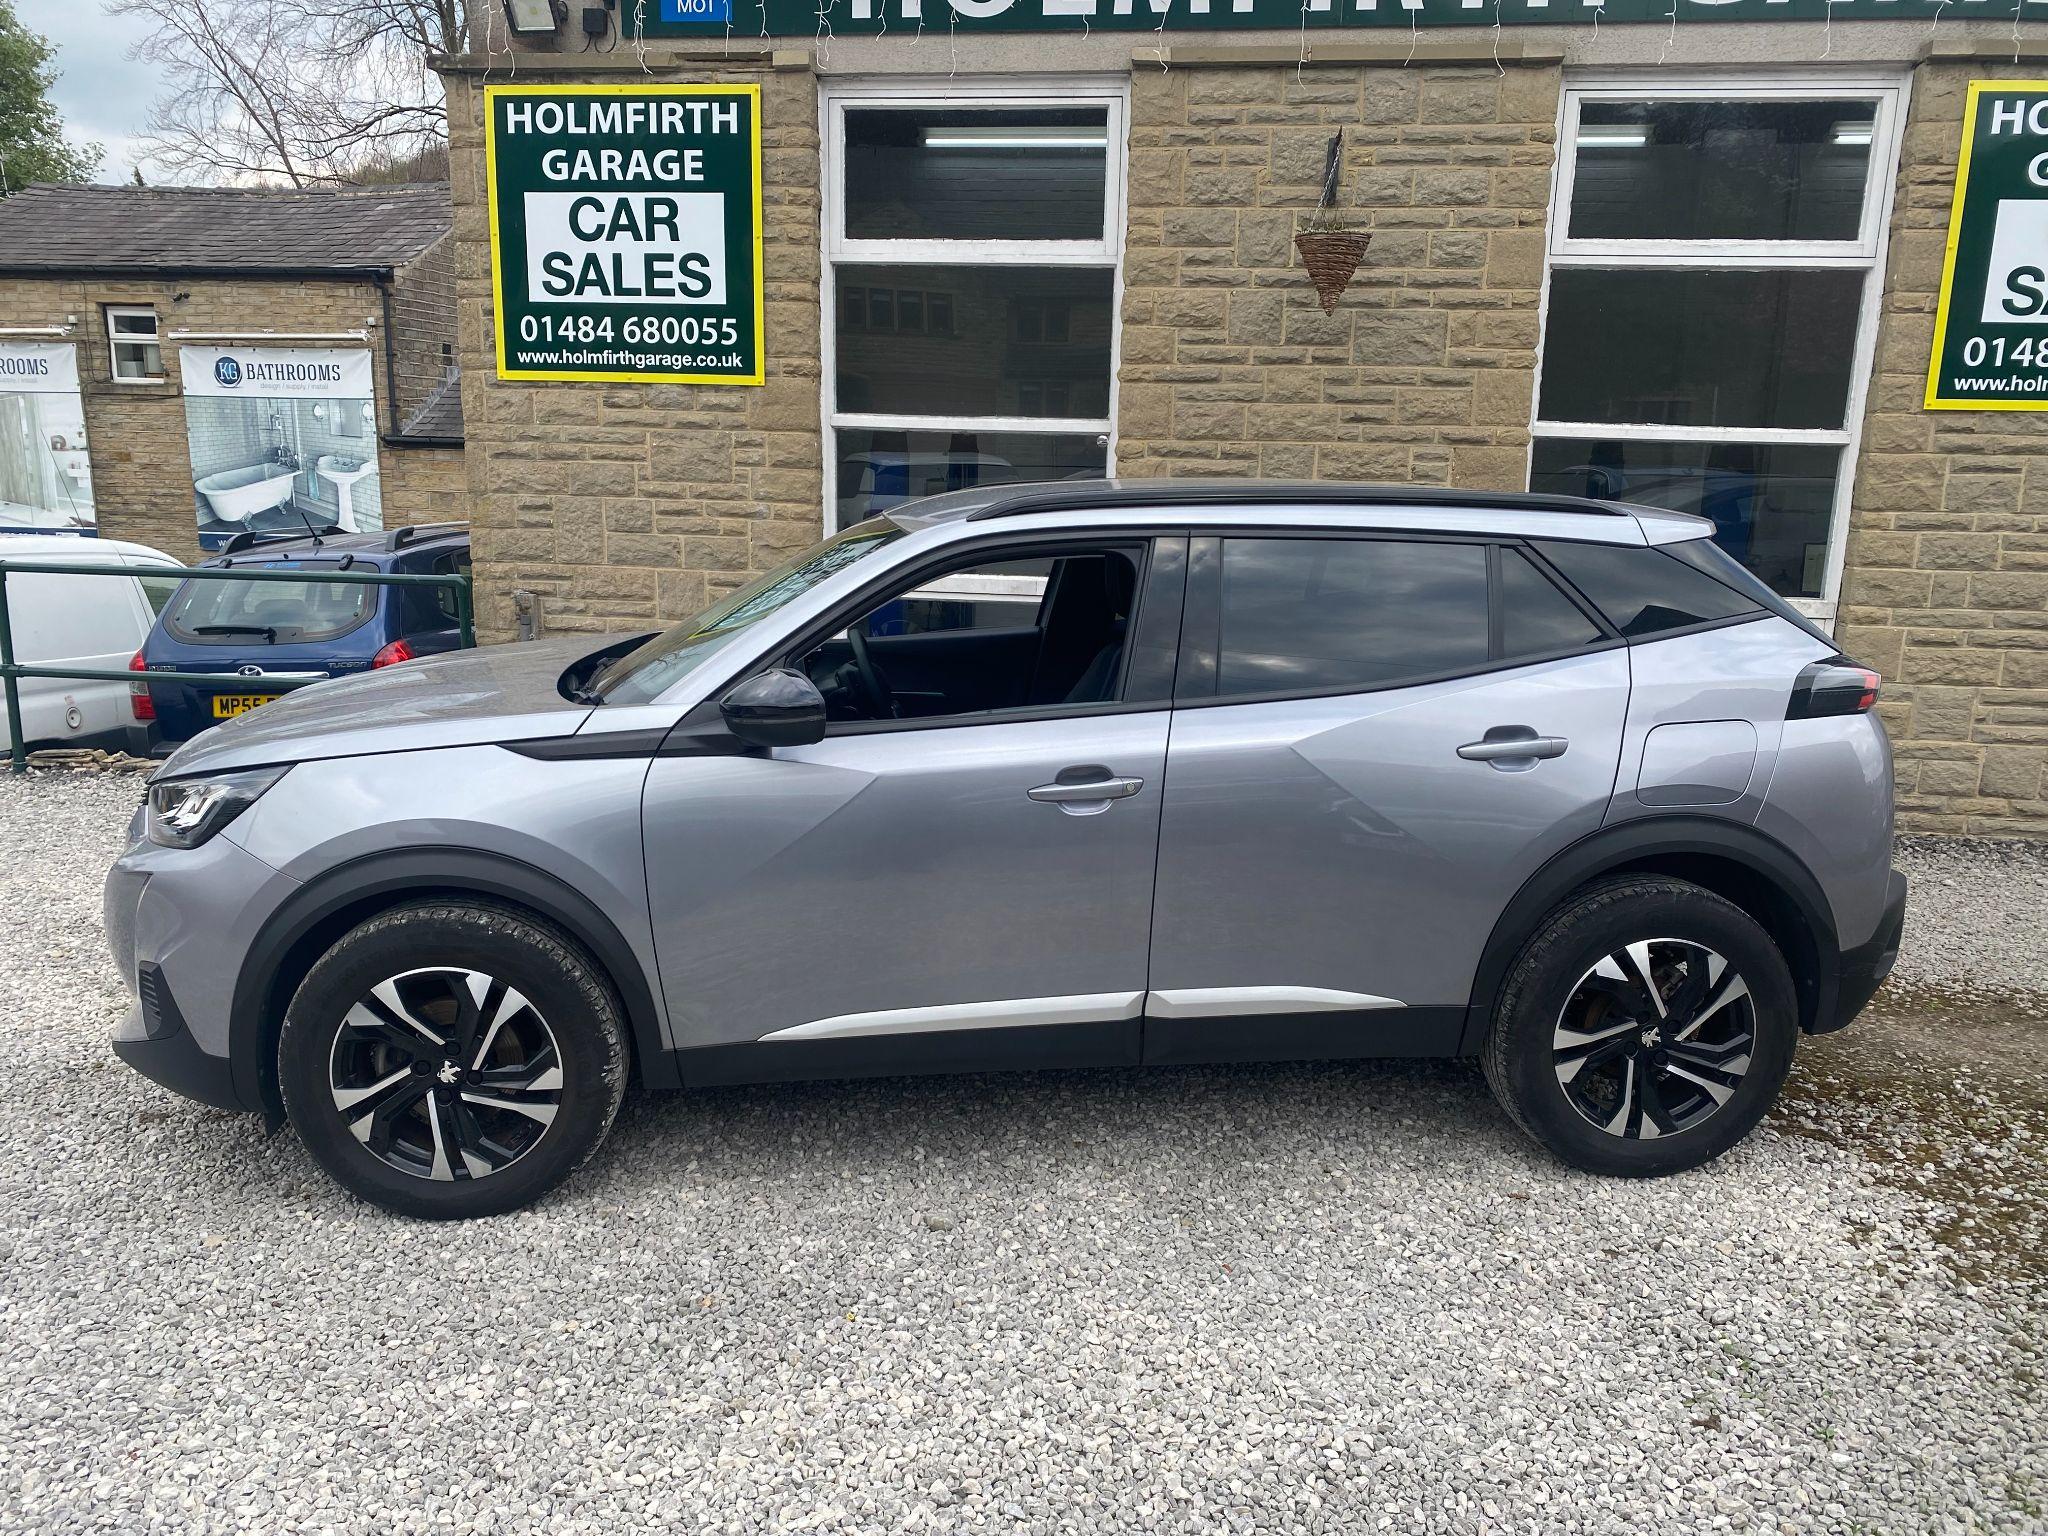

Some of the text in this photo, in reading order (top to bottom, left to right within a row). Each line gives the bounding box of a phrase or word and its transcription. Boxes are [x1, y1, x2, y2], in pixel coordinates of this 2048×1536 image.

[506, 102, 738, 134] HOLMFIRTH
[541, 149, 704, 181] GARAGE
[568, 196, 680, 242] CAR
[542, 251, 712, 298] SALES
[2002, 265, 2048, 316] S
[520, 315, 738, 345] 01484 680055
[218, 362, 341, 381] KG BATHROOMS
[517, 349, 743, 369] www.holmfirthgarage.co.uk
